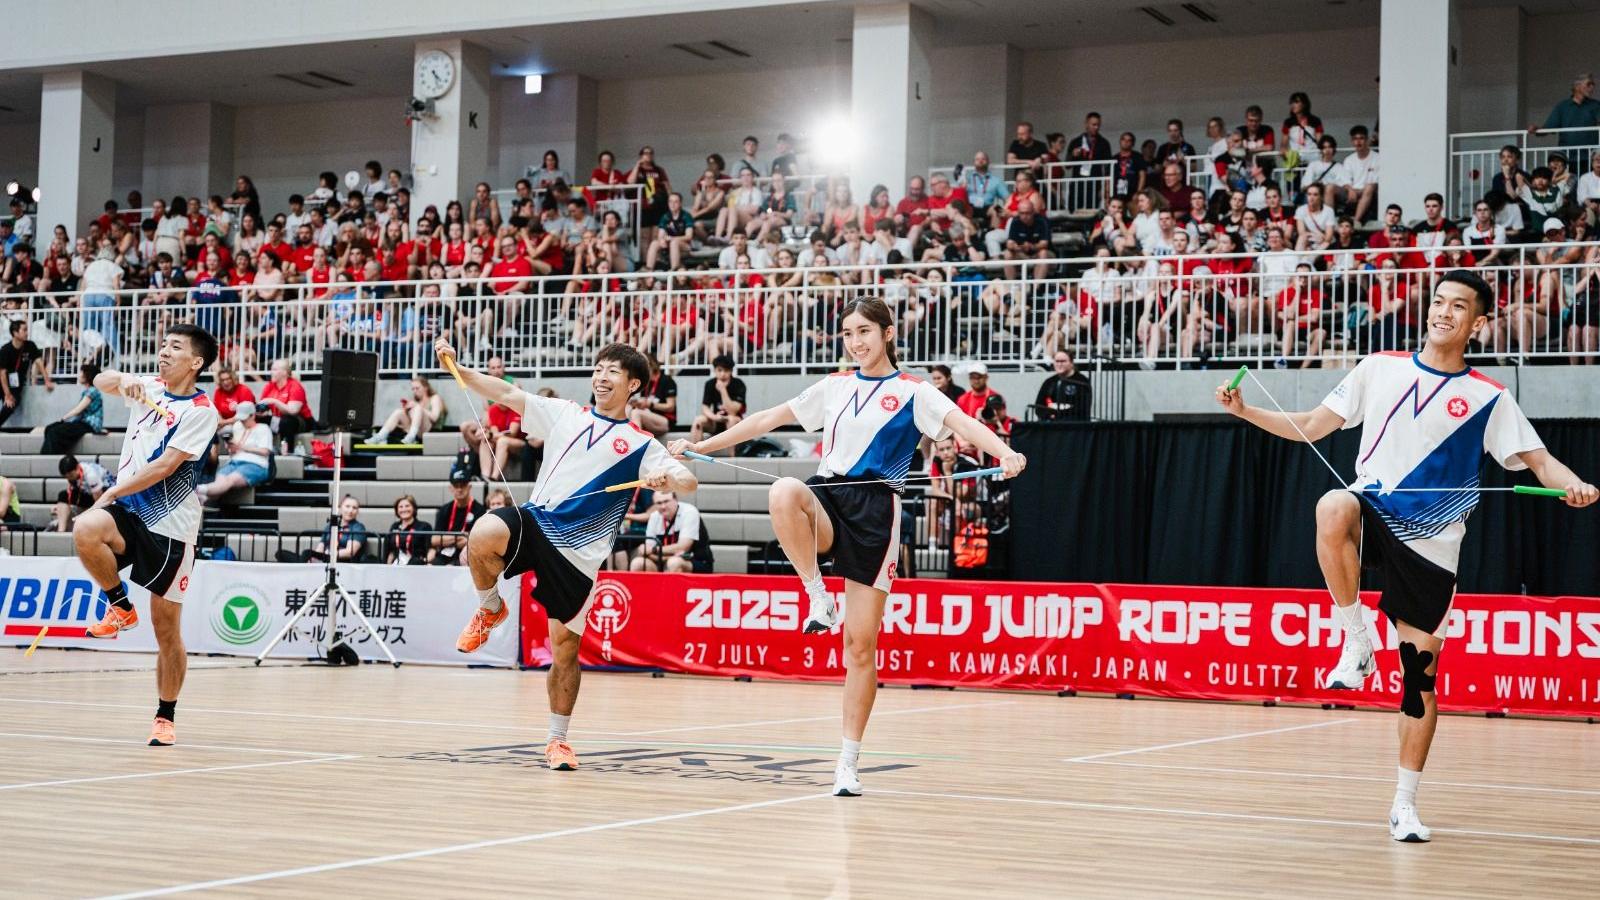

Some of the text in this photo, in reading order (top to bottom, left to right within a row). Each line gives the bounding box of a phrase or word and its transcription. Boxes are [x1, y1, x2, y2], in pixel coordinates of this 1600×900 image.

[468, 111, 478, 129] K
[92, 137, 101, 152] J
[284, 588, 407, 619] 東急不動産
[685, 588, 800, 631] 2025
[812, 592, 972, 635] RLD
[982, 593, 1103, 644] JUMP
[1117, 599, 1253, 647] ROPE
[1270, 602, 1600, 660] CHAPIONS
[683, 642, 708, 664] 27
[718, 643, 769, 666] JULY
[803, 646, 814, 669] 3
[826, 647, 914, 672] AUST
[949, 651, 1079, 679] KAWASAKI,
[1092, 656, 1168, 682] JAPAN
[1208, 661, 1299, 689] CULTTZ
[1314, 666, 1450, 697] KASI
